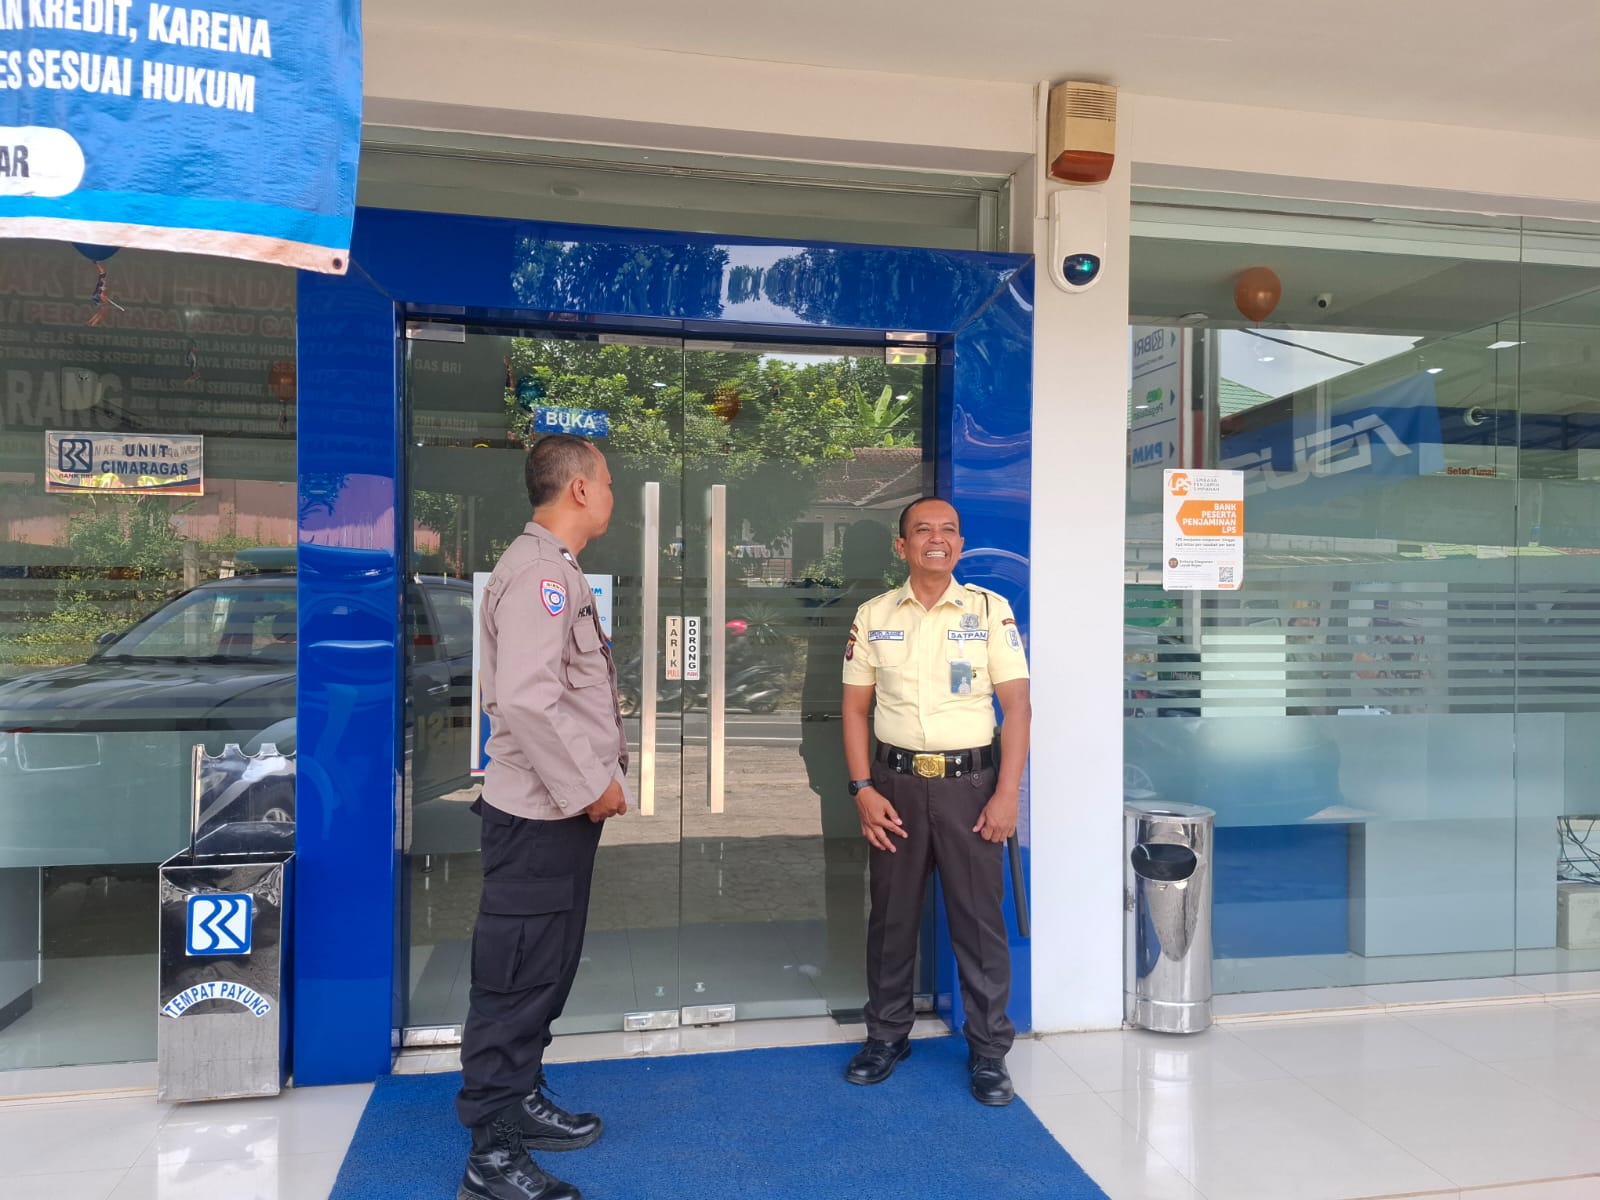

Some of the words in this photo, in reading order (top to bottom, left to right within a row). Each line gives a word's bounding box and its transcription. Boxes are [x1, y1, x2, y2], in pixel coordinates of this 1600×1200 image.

[29, 0, 137, 43] KREDIT,
[148, 5, 271, 58] KARENA
[28, 48, 131, 97] SESUAI
[143, 60, 255, 113] HUKUM
[545, 412, 595, 430] BUKA
[125, 444, 168, 458] UNIT
[101, 460, 189, 476] CIMARAGAS
[1201, 510, 1237, 518] PESERTA
[1214, 503, 1237, 511] BANK
[1182, 518, 1237, 526] PENJAMINAN
[1221, 526, 1237, 534] LPS
[670, 617, 680, 669] TARIK
[950, 631, 987, 640] SATPAM
[688, 619, 697, 670] DORONG
[164, 983, 217, 1018] TEMPAT
[220, 983, 270, 1018] PAYUNG
